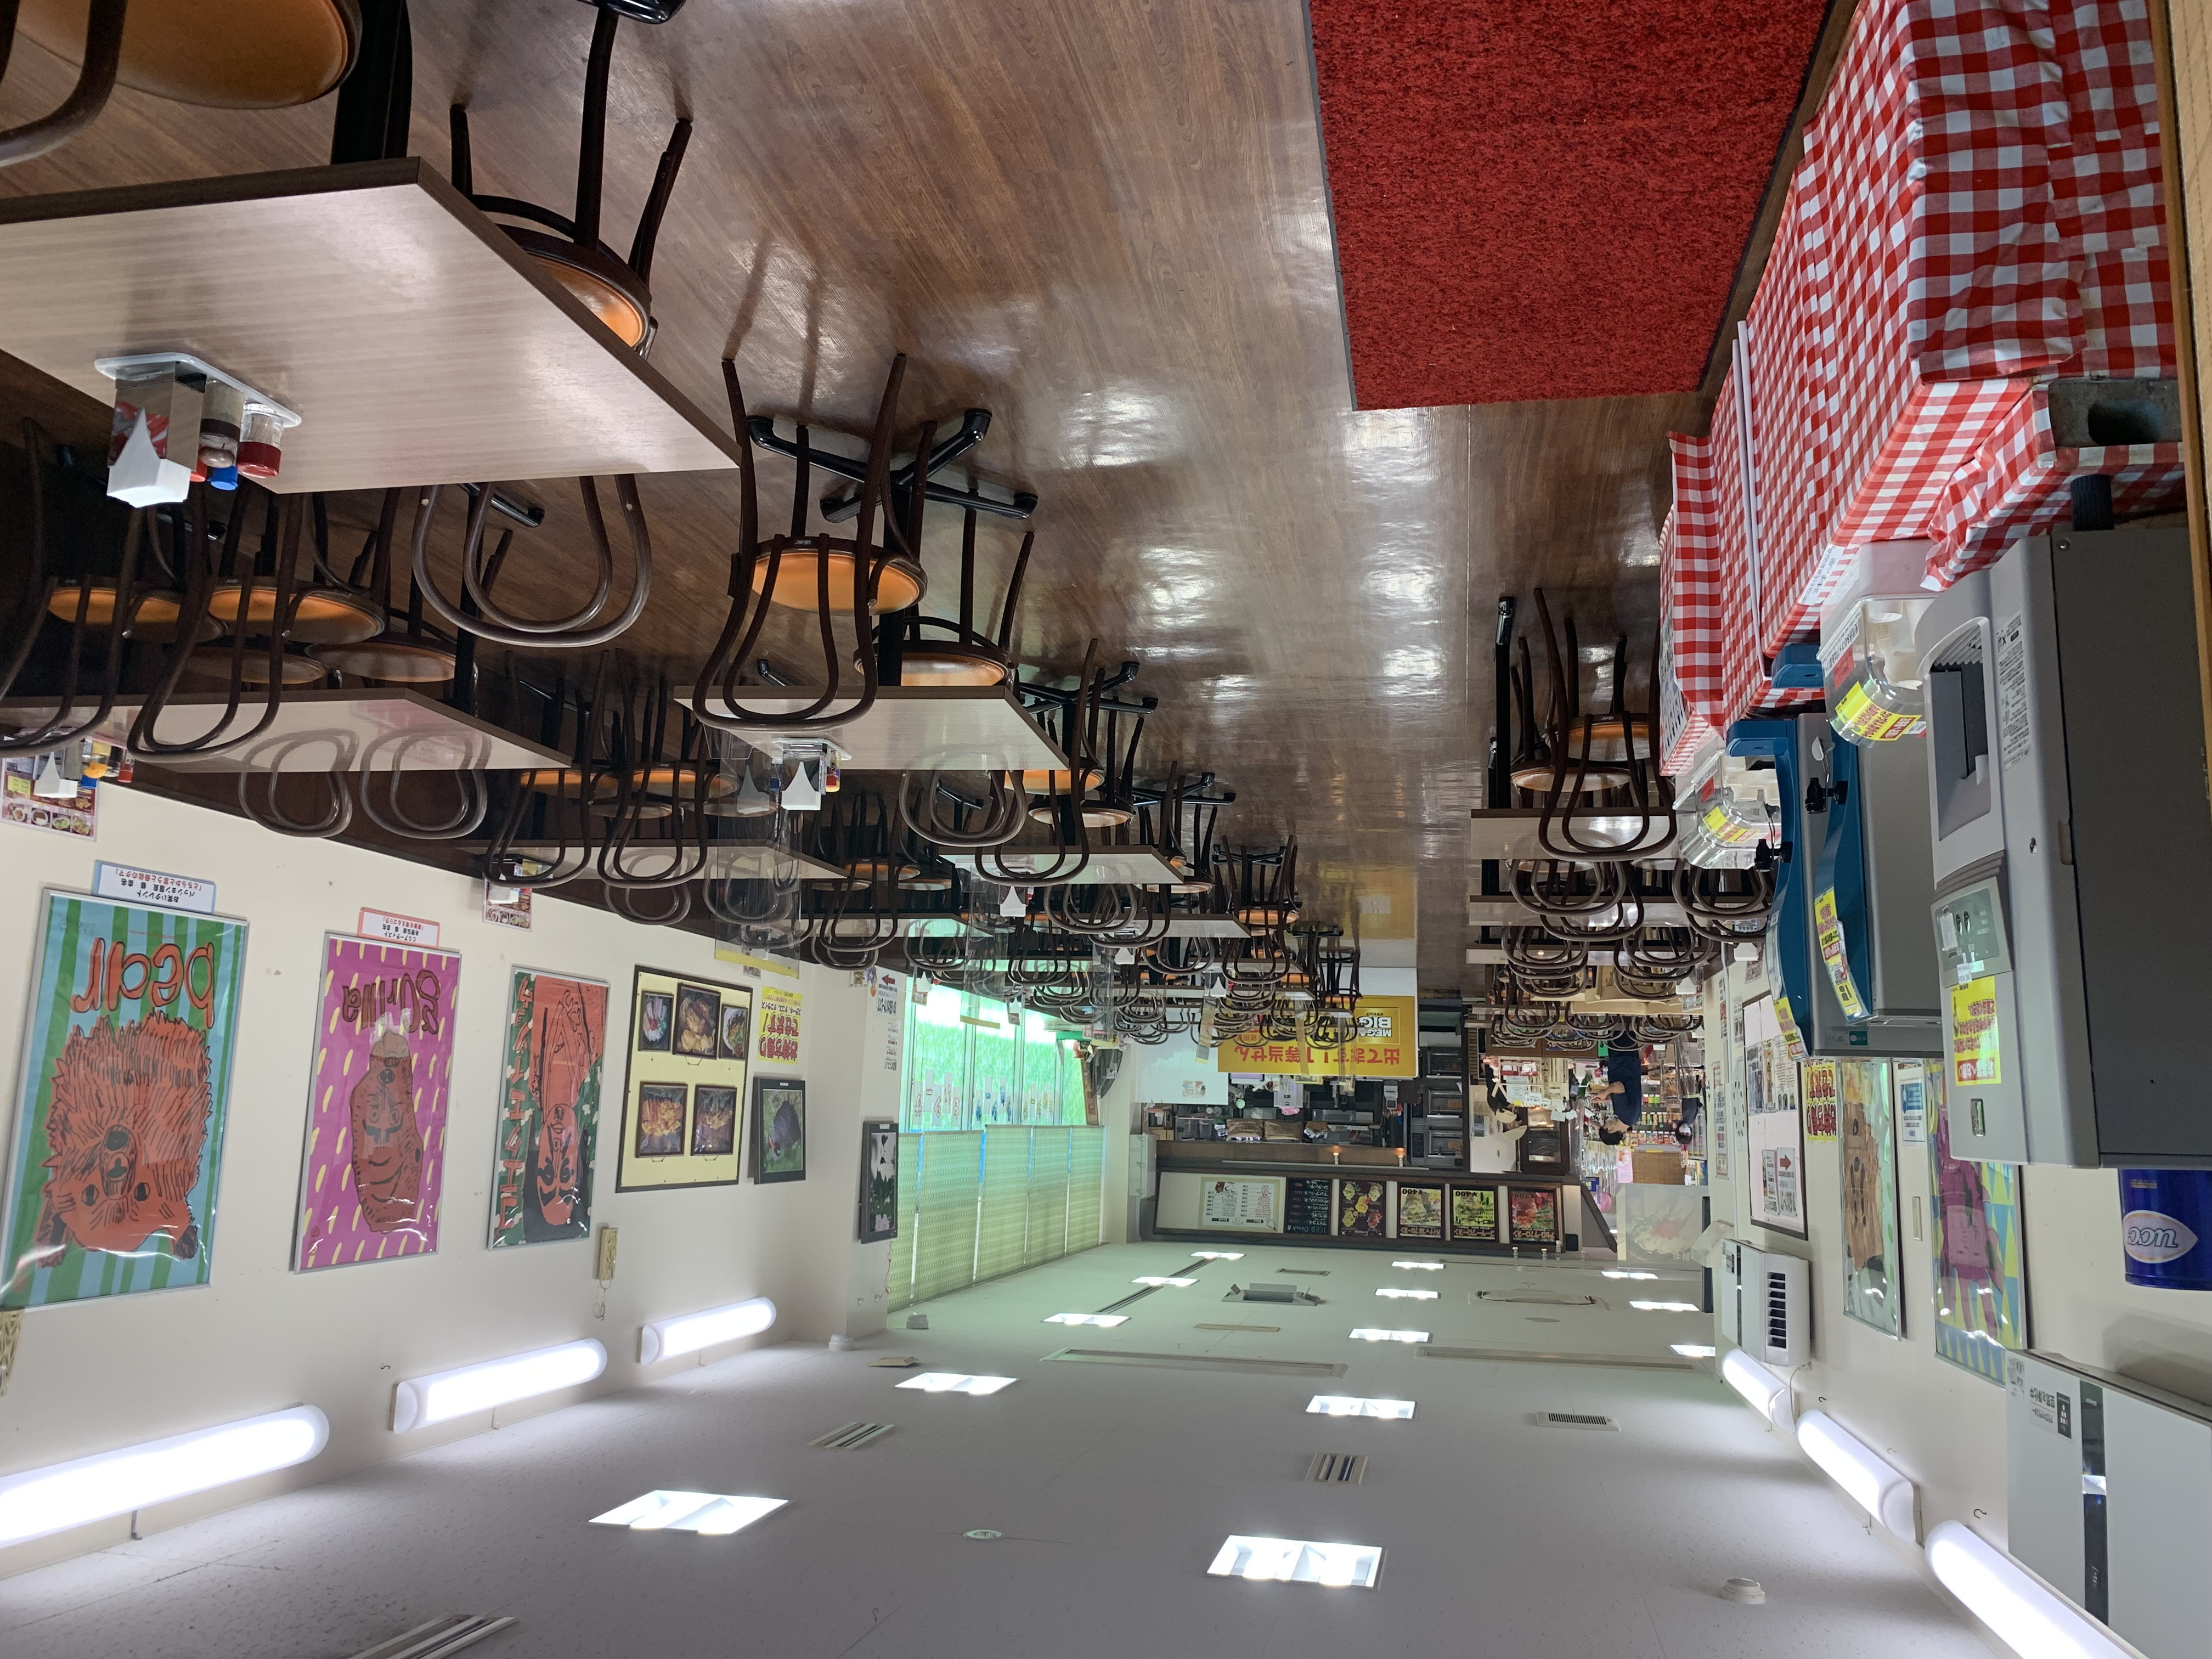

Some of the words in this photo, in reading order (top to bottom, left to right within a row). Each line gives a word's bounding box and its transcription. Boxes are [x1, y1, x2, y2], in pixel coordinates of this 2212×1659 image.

[115, 868, 202, 890] 「どちらかと言うと母似のクマ」
[121, 878, 133, 887] 命名
[137, 890, 179, 903] お笑いタレント
[153, 884, 195, 897] パッション屋良
[71, 938, 215, 1029] bear
[1358, 1017, 1392, 1029] BIG
[759, 1035, 798, 1061] お持ち帰り
[1807, 1103, 1836, 1136] お持ち帰り
[2029, 1387, 2055, 1408] 空気を浄化中
